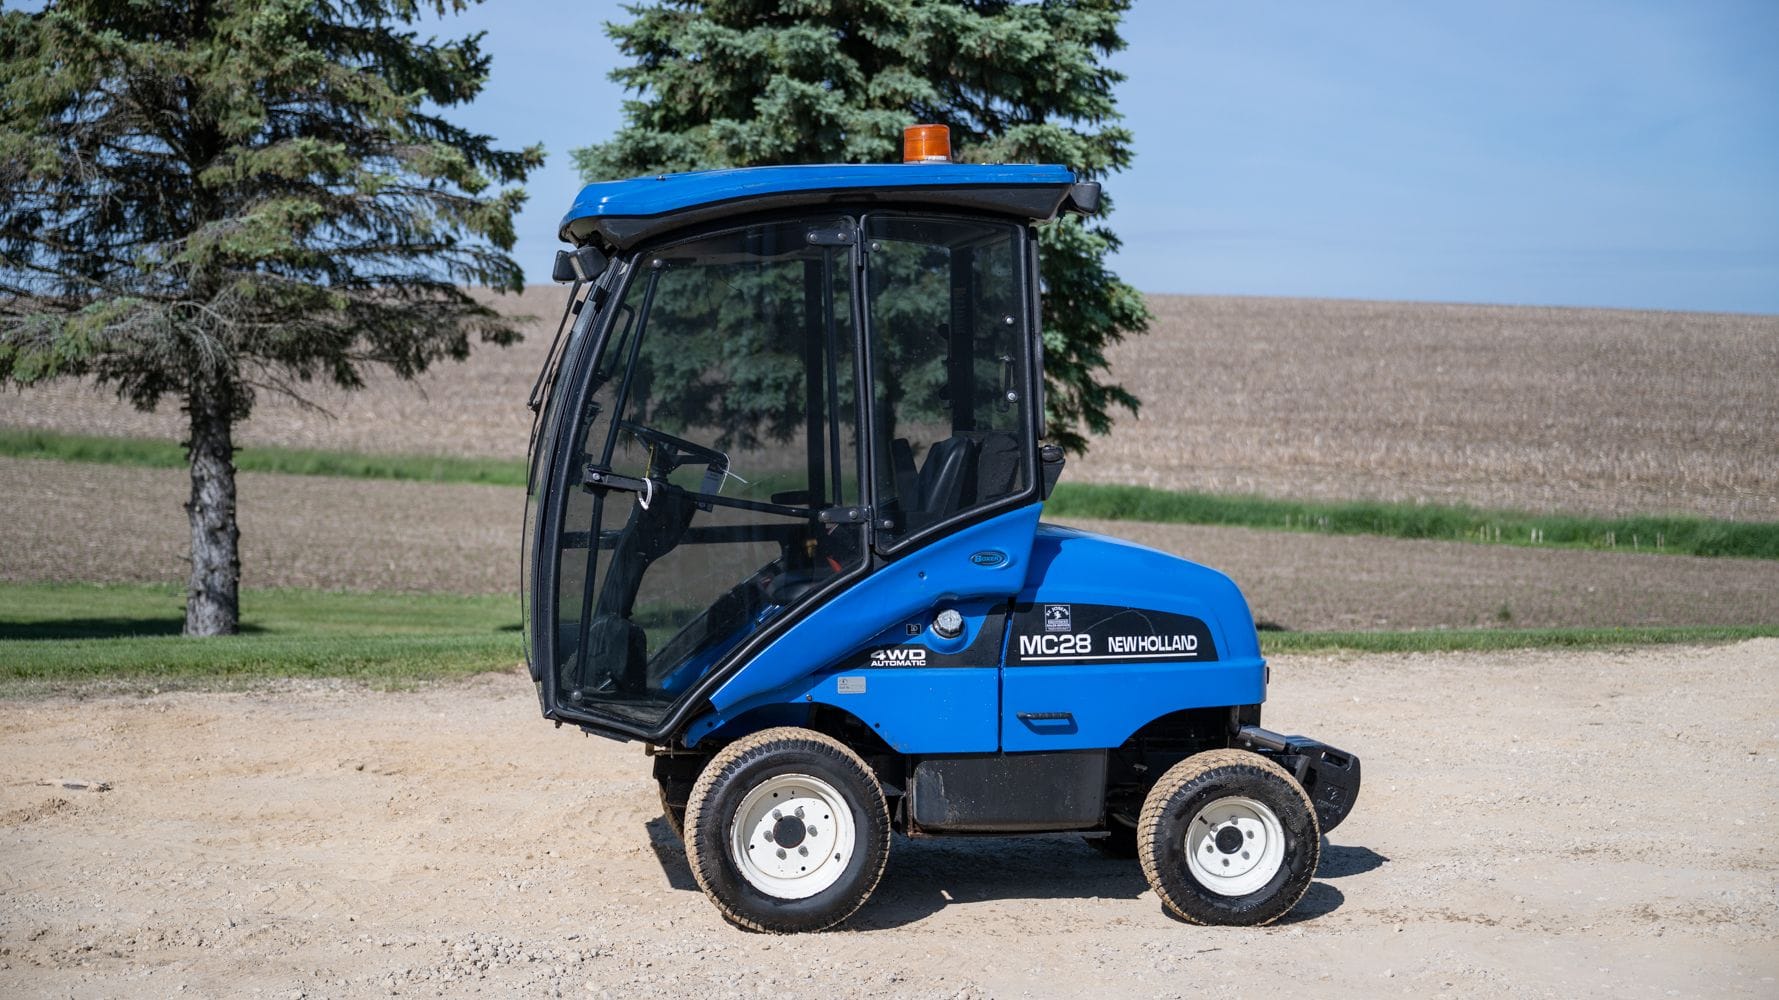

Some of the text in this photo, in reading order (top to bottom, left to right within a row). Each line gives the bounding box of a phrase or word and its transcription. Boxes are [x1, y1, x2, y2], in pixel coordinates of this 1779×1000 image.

[1019, 633, 1092, 655] MC28
[1108, 634, 1198, 653] NEW HOLLAND
[870, 649, 926, 660] 4WD
